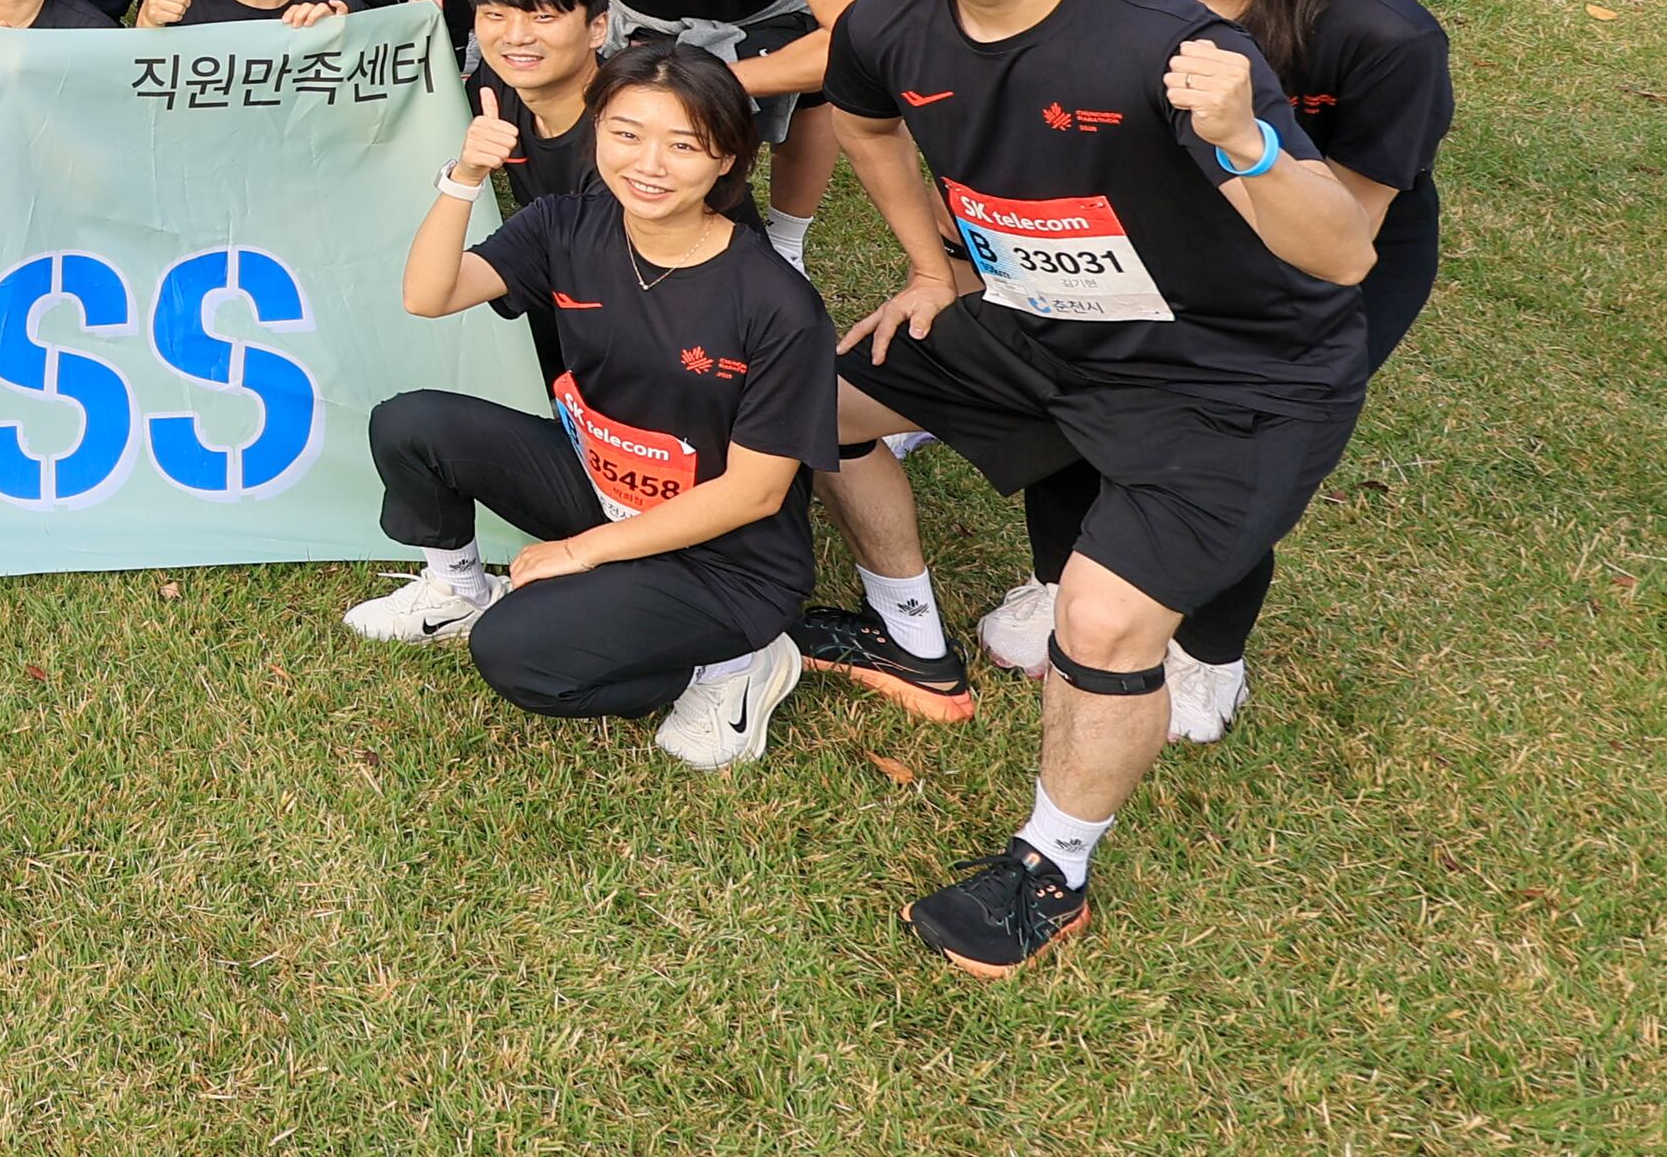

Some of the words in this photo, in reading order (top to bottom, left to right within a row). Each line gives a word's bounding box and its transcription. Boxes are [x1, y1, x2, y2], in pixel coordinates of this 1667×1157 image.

[131, 35, 435, 111] 직원만족센터
[960, 196, 993, 224] SK
[992, 211, 1090, 232] telecom
[968, 229, 998, 264] B
[1013, 247, 1125, 275] 33031
[1053, 299, 1104, 314] 춘천시
[565, 392, 585, 427] SK
[587, 421, 670, 461] telecom
[565, 411, 580, 445] B
[589, 449, 680, 500] 35458
